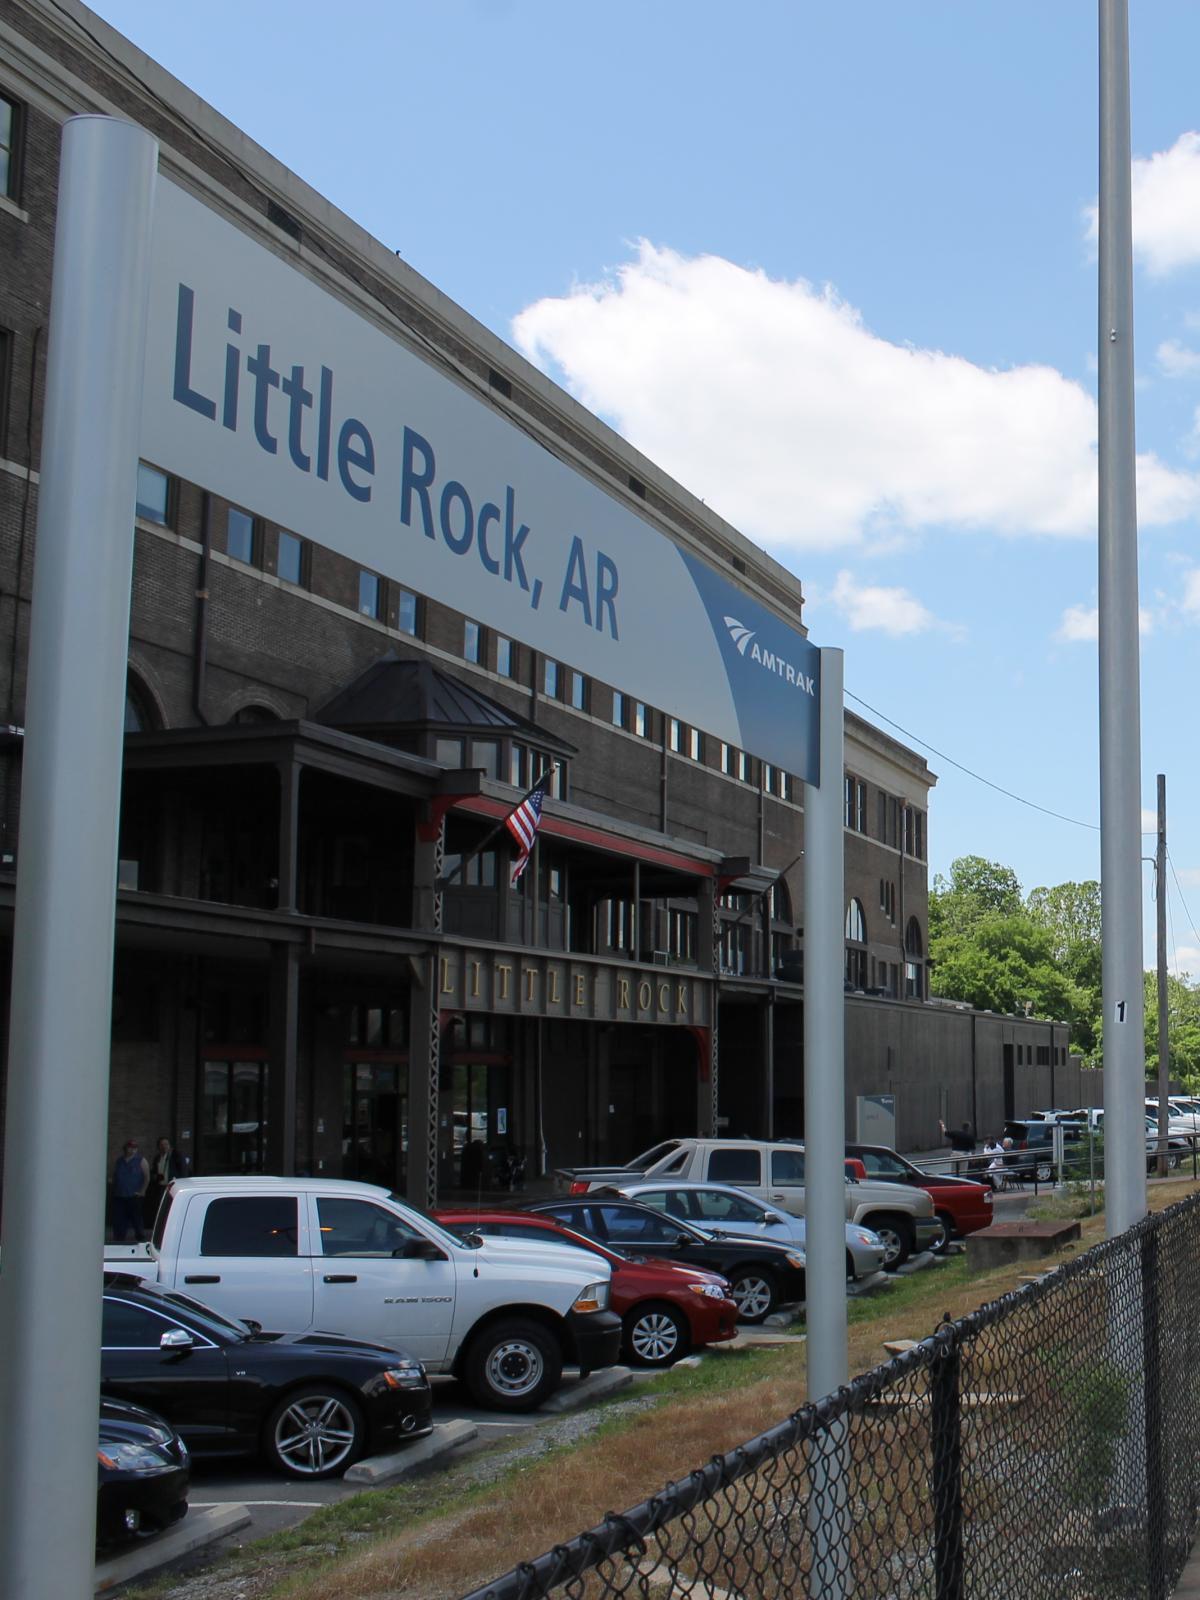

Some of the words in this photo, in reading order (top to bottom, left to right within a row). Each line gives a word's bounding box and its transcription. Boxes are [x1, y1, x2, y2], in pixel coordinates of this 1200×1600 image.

[173, 282, 375, 502] Little
[400, 425, 543, 610] Rock,
[559, 535, 619, 641] AR
[751, 642, 815, 697] AMTRAK
[441, 958, 585, 1005] LITTLE
[619, 979, 687, 1013] ROCK
[1117, 1001, 1125, 1022] 1
